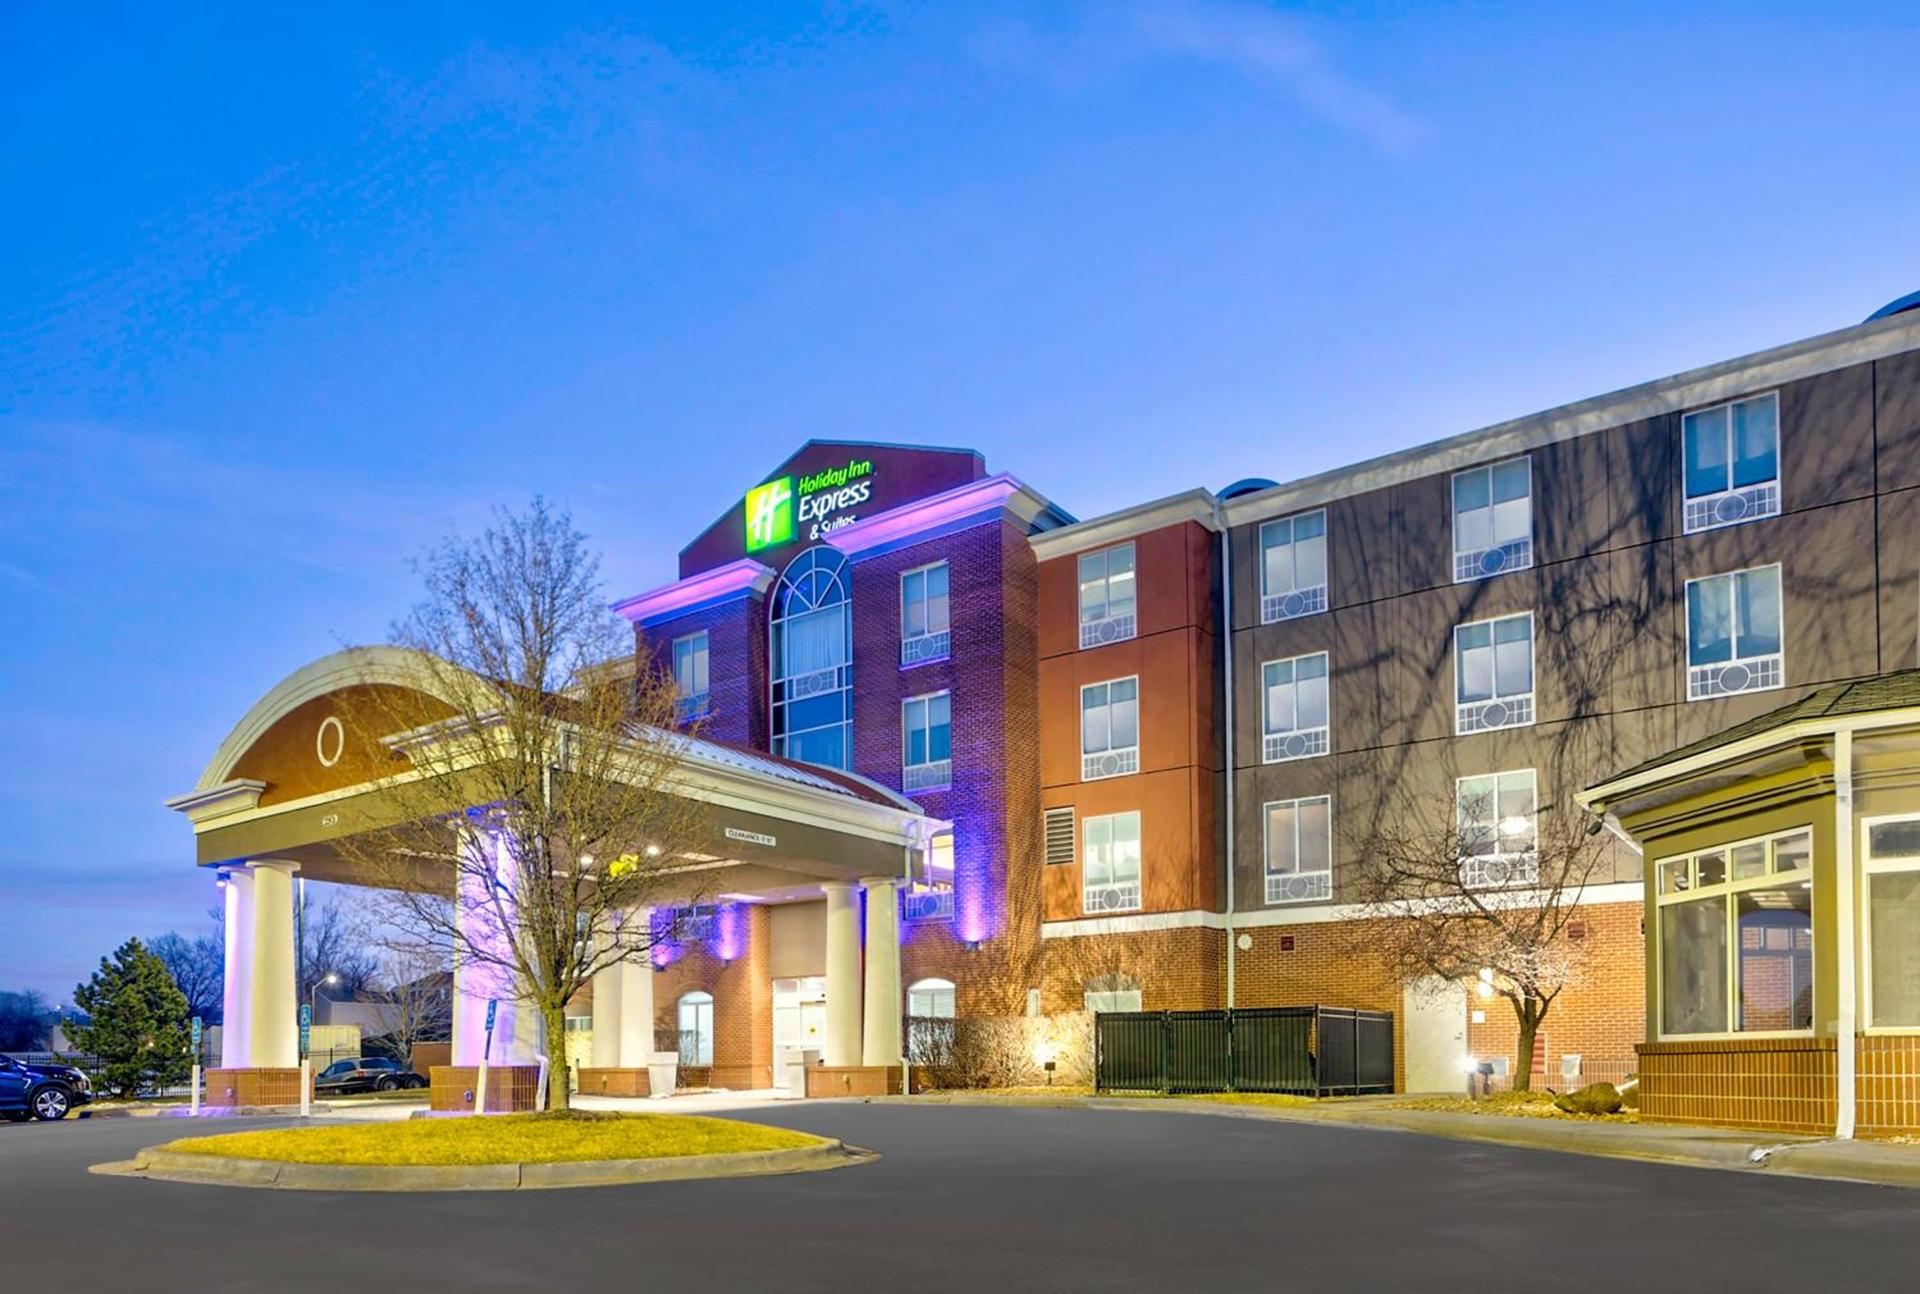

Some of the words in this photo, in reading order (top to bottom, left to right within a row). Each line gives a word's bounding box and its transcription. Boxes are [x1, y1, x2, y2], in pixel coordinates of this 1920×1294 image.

[798, 468, 848, 496] Holiday
[848, 460, 871, 478] Inn
[798, 481, 871, 522] Express
[809, 524, 820, 540] &
